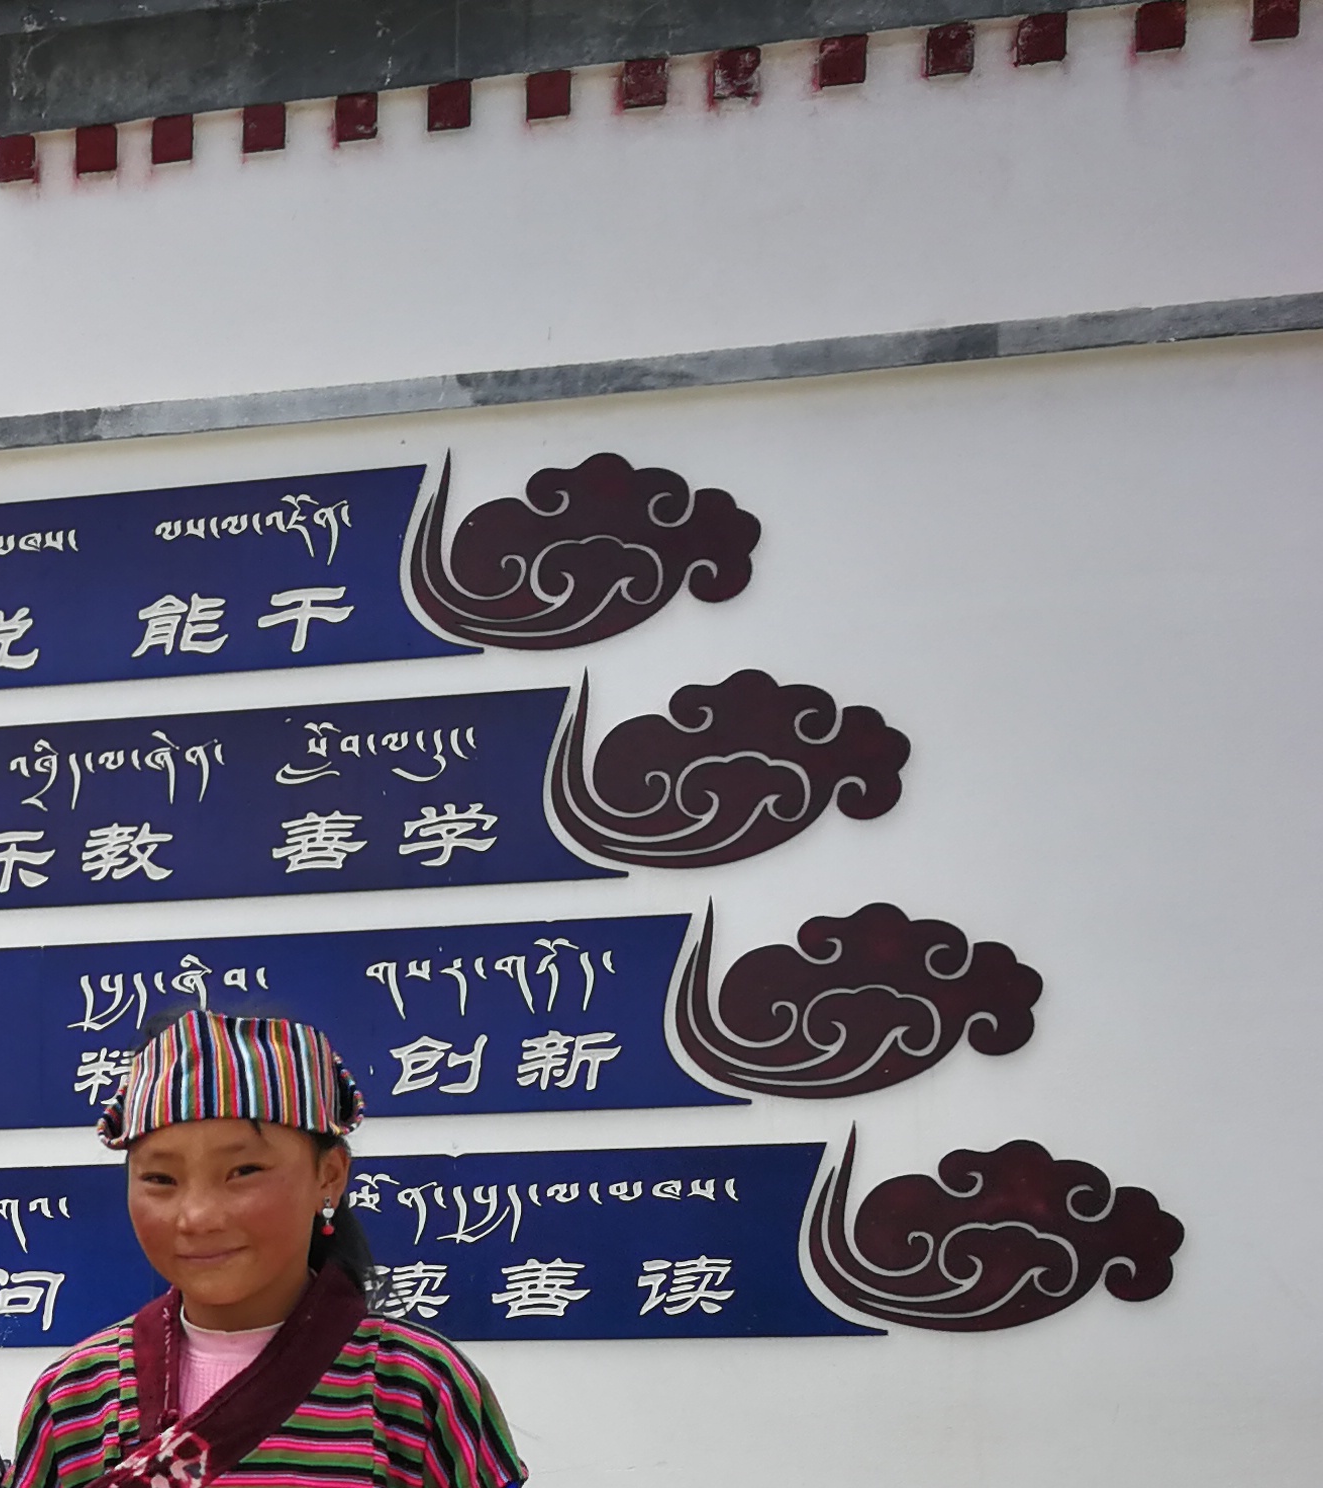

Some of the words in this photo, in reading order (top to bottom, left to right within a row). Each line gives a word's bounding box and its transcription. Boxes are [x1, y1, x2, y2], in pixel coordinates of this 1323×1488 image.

[131, 586, 355, 658] 能干
[271, 802, 499, 874] 善学
[388, 1030, 623, 1095] 创新
